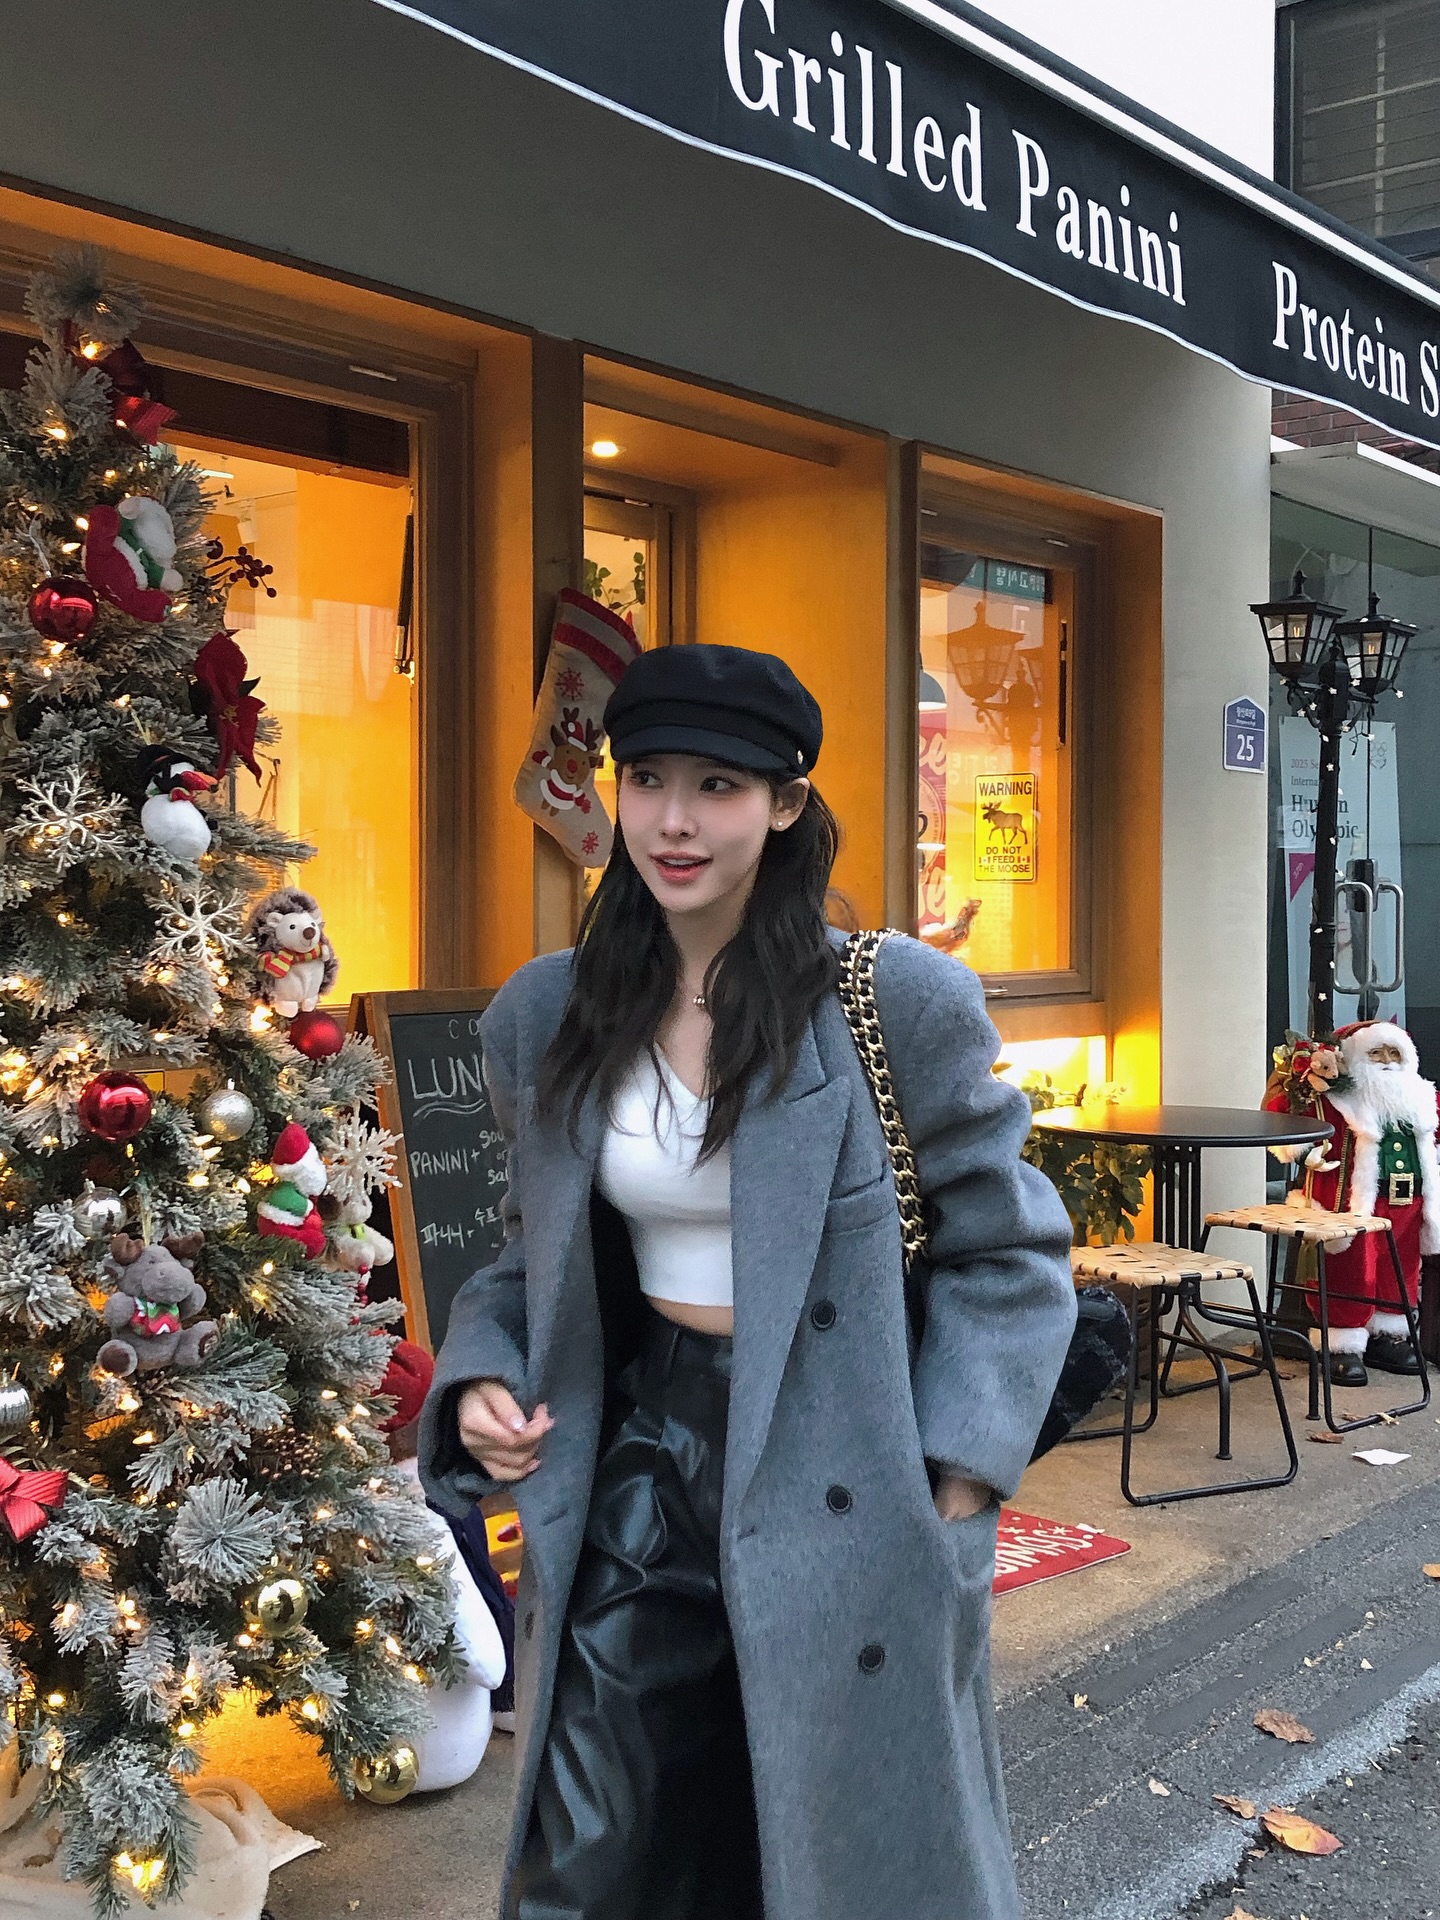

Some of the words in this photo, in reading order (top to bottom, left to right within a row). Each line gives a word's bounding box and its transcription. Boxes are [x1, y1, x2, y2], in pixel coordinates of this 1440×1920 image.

[723, 0, 987, 212] Grilled
[1012, 129, 1186, 306] Panini
[1272, 261, 1410, 405] Protein
[1420, 341, 1440, 417] S
[1236, 733, 1254, 761] 25
[979, 781, 1032, 796] WARNING
[1290, 775, 1318, 786] Interna
[1291, 794, 1349, 813] Hun
[1292, 819, 1359, 842] Olypic
[986, 846, 999, 855] DO
[1002, 846, 1022, 855] NOT
[993, 855, 1015, 864] FEED
[979, 864, 997, 873] THE
[998, 864, 1031, 873] MOOSE
[479, 1130, 505, 1149] Sou
[487, 1166, 510, 1185] Sal
